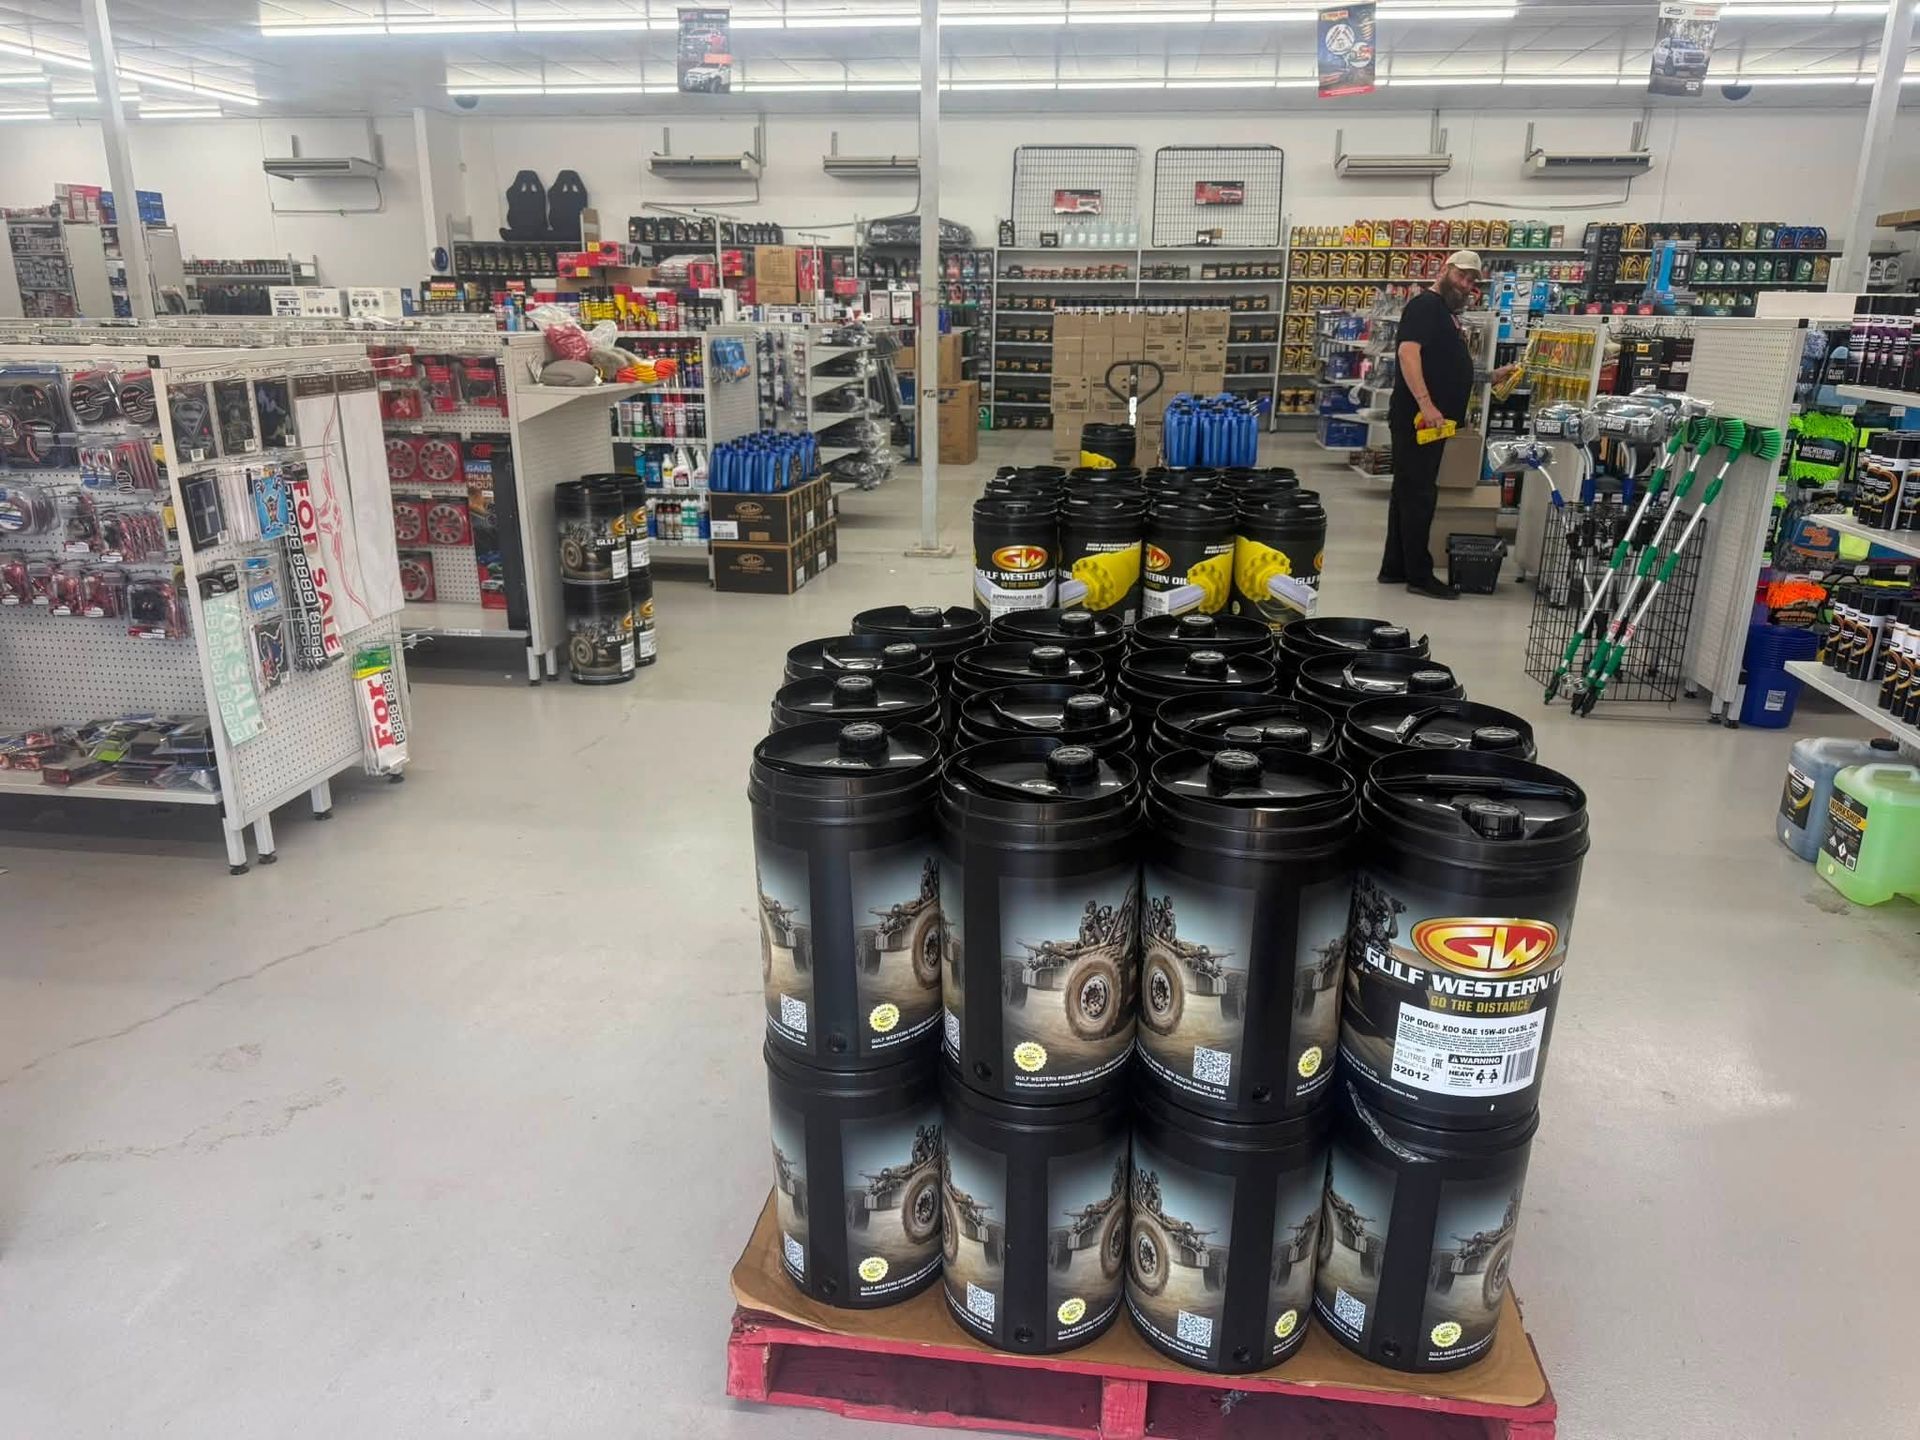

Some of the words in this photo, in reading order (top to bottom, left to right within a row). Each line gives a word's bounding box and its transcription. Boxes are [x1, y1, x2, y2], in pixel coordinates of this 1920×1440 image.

[466, 464, 492, 473] GAUG
[993, 549, 1042, 568] GW
[1001, 570, 1047, 581] WESTERN
[254, 586, 276, 604] WASH
[312, 567, 341, 652] SALE
[367, 679, 395, 749] For
[1830, 799, 1862, 825] WORKSHOP
[1427, 926, 1547, 969] GW
[1365, 945, 1425, 985] GULF
[1431, 971, 1550, 998] WESTERN
[1430, 995, 1447, 1008] GO
[1451, 998, 1473, 1012] THE
[1476, 999, 1531, 1014] DISTANCE
[1400, 1012, 1416, 1024] TOP
[1442, 1023, 1460, 1035] XDO
[1461, 1027, 1478, 1036] SAE
[1480, 1026, 1507, 1036] 15W-40
[1404, 1050, 1427, 1064] LITRES
[1459, 1056, 1501, 1065] WARNING
[1058, 1073, 1081, 1081] PREMIUM
[1393, 1063, 1430, 1082] 32012
